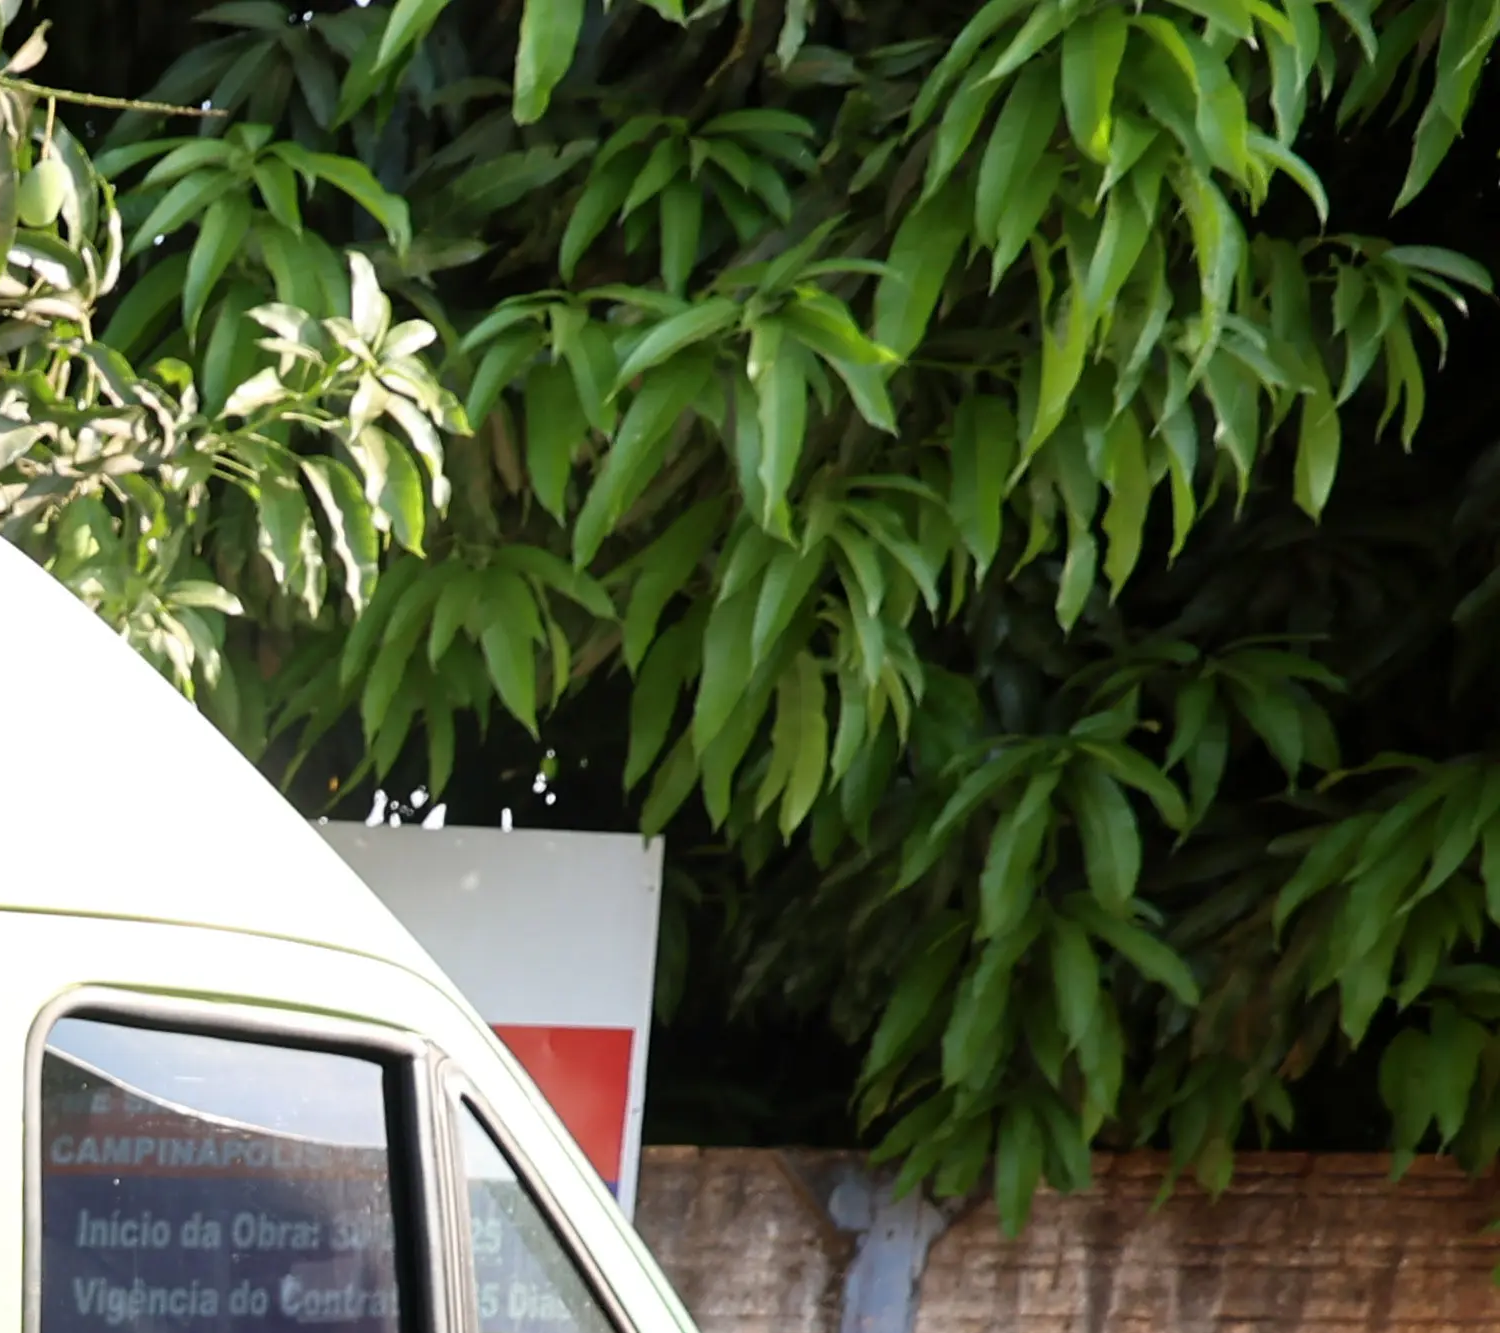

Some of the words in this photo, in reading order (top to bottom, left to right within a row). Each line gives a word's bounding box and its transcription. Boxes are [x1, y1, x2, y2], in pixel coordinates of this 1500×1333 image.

[75, 1208, 171, 1249] Início
[181, 1212, 222, 1249] da
[73, 1276, 219, 1326] Vigência
[229, 1278, 269, 1318] do
